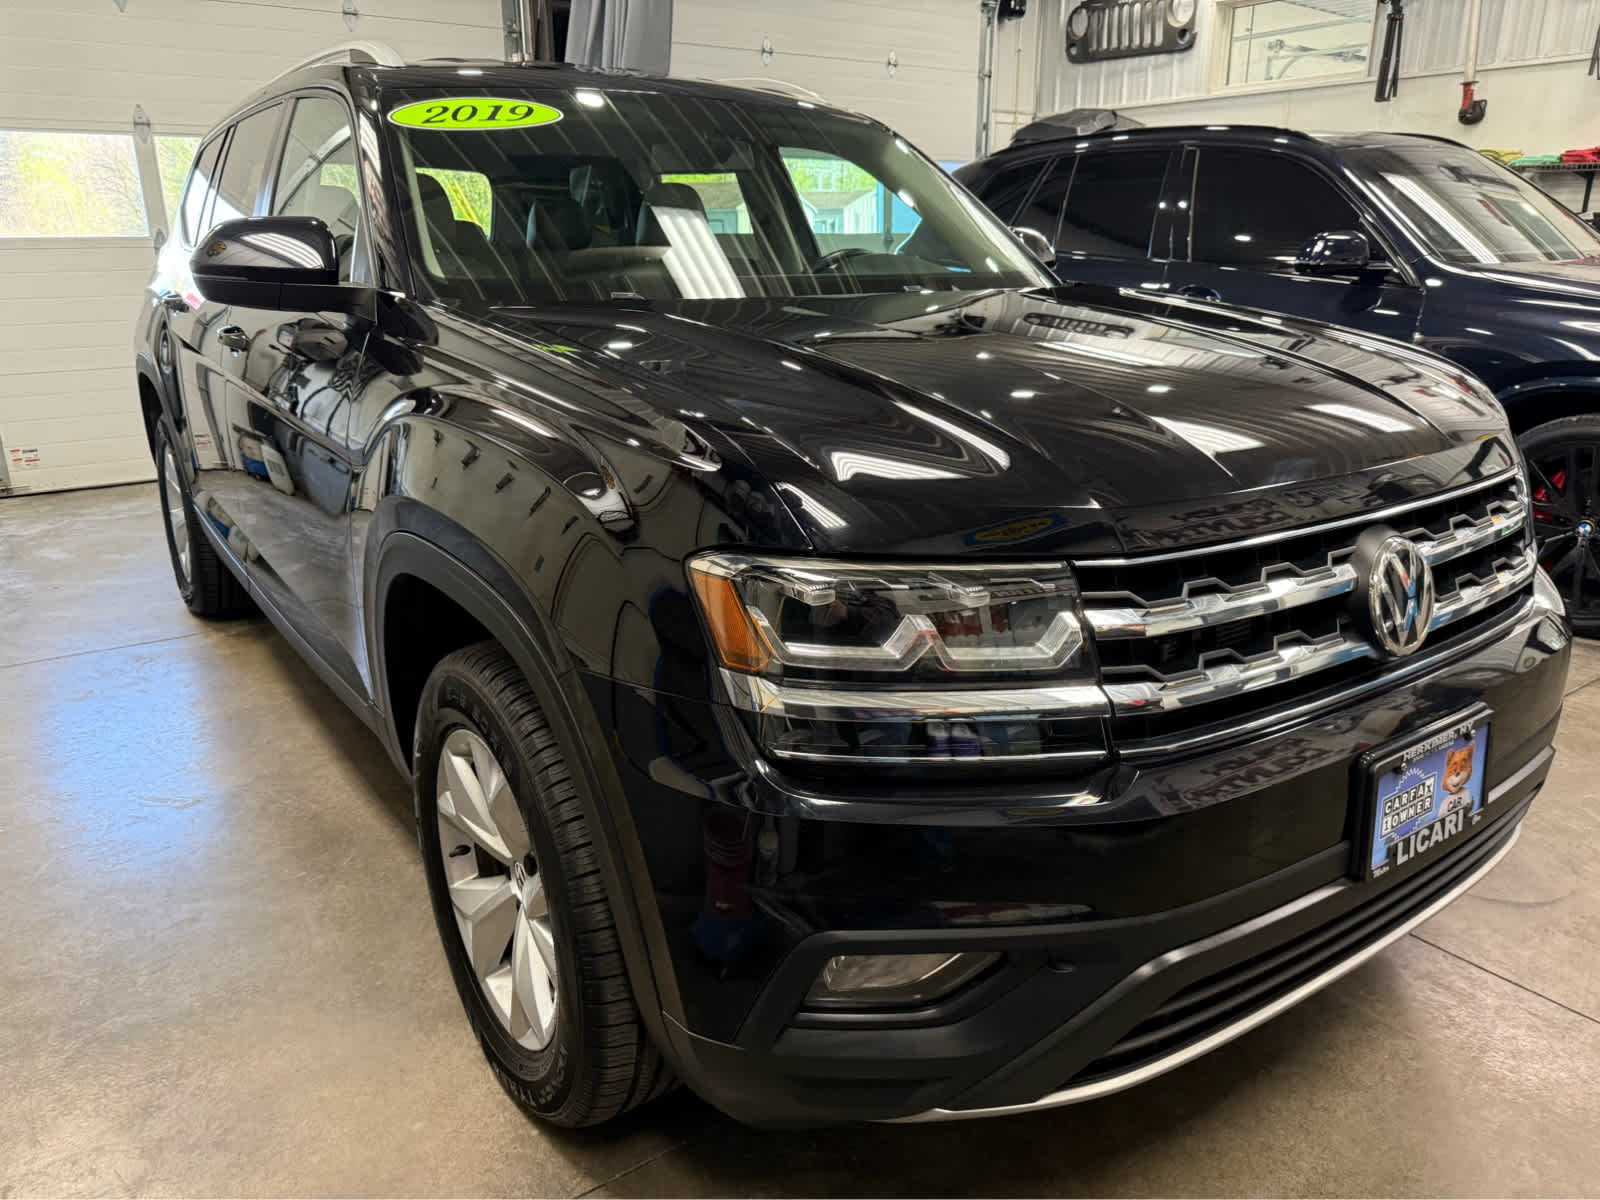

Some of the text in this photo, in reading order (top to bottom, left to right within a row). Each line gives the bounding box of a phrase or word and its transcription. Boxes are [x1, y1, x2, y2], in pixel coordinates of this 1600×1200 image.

[421, 104, 534, 124] 2019
[1385, 780, 1434, 814] CARFAX
[1397, 808, 1465, 866] LICARI
